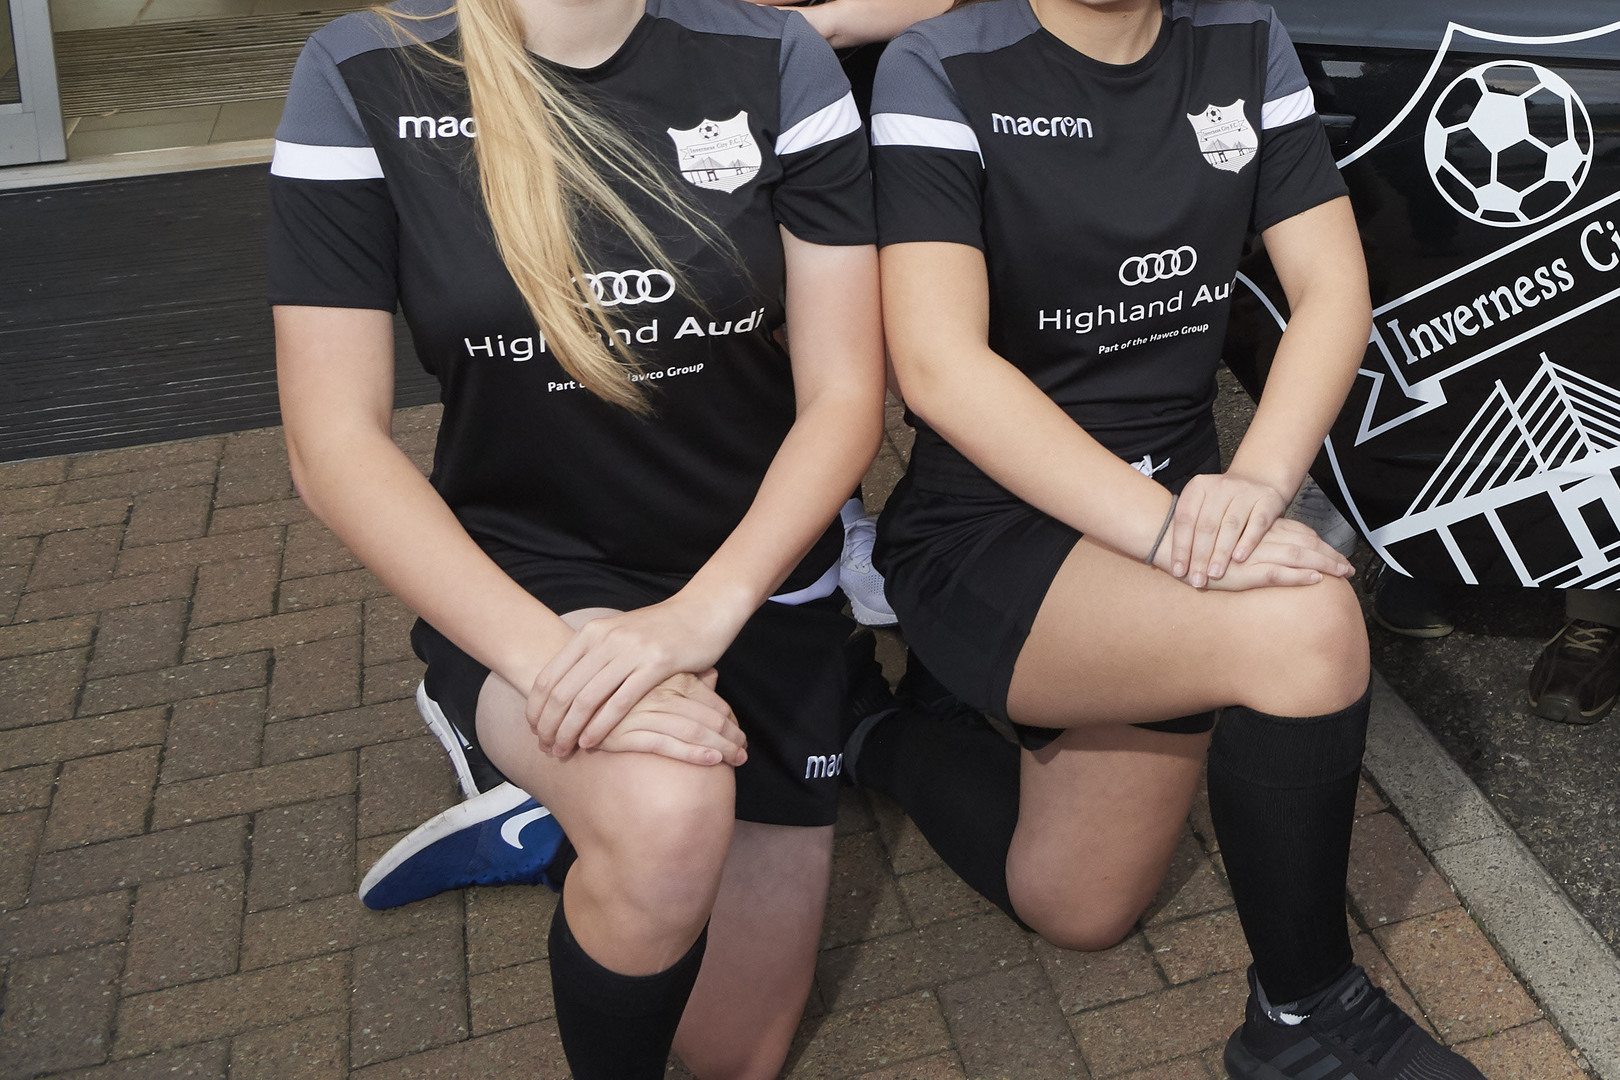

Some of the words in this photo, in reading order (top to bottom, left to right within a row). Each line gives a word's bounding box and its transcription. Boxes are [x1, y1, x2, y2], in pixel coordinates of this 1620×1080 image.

[398, 115, 478, 139] mac
[991, 112, 1094, 139] macron
[1038, 289, 1184, 335] Highland
[1191, 276, 1237, 308] Au
[1386, 256, 1576, 366] Inverness
[673, 307, 766, 340] Audi
[1098, 344, 1120, 355] Part
[1120, 339, 1132, 350] of
[1132, 336, 1148, 346] the
[1149, 329, 1180, 342] Hawco
[1181, 322, 1210, 335] Group
[547, 380, 576, 393] Part
[666, 362, 705, 377] Group
